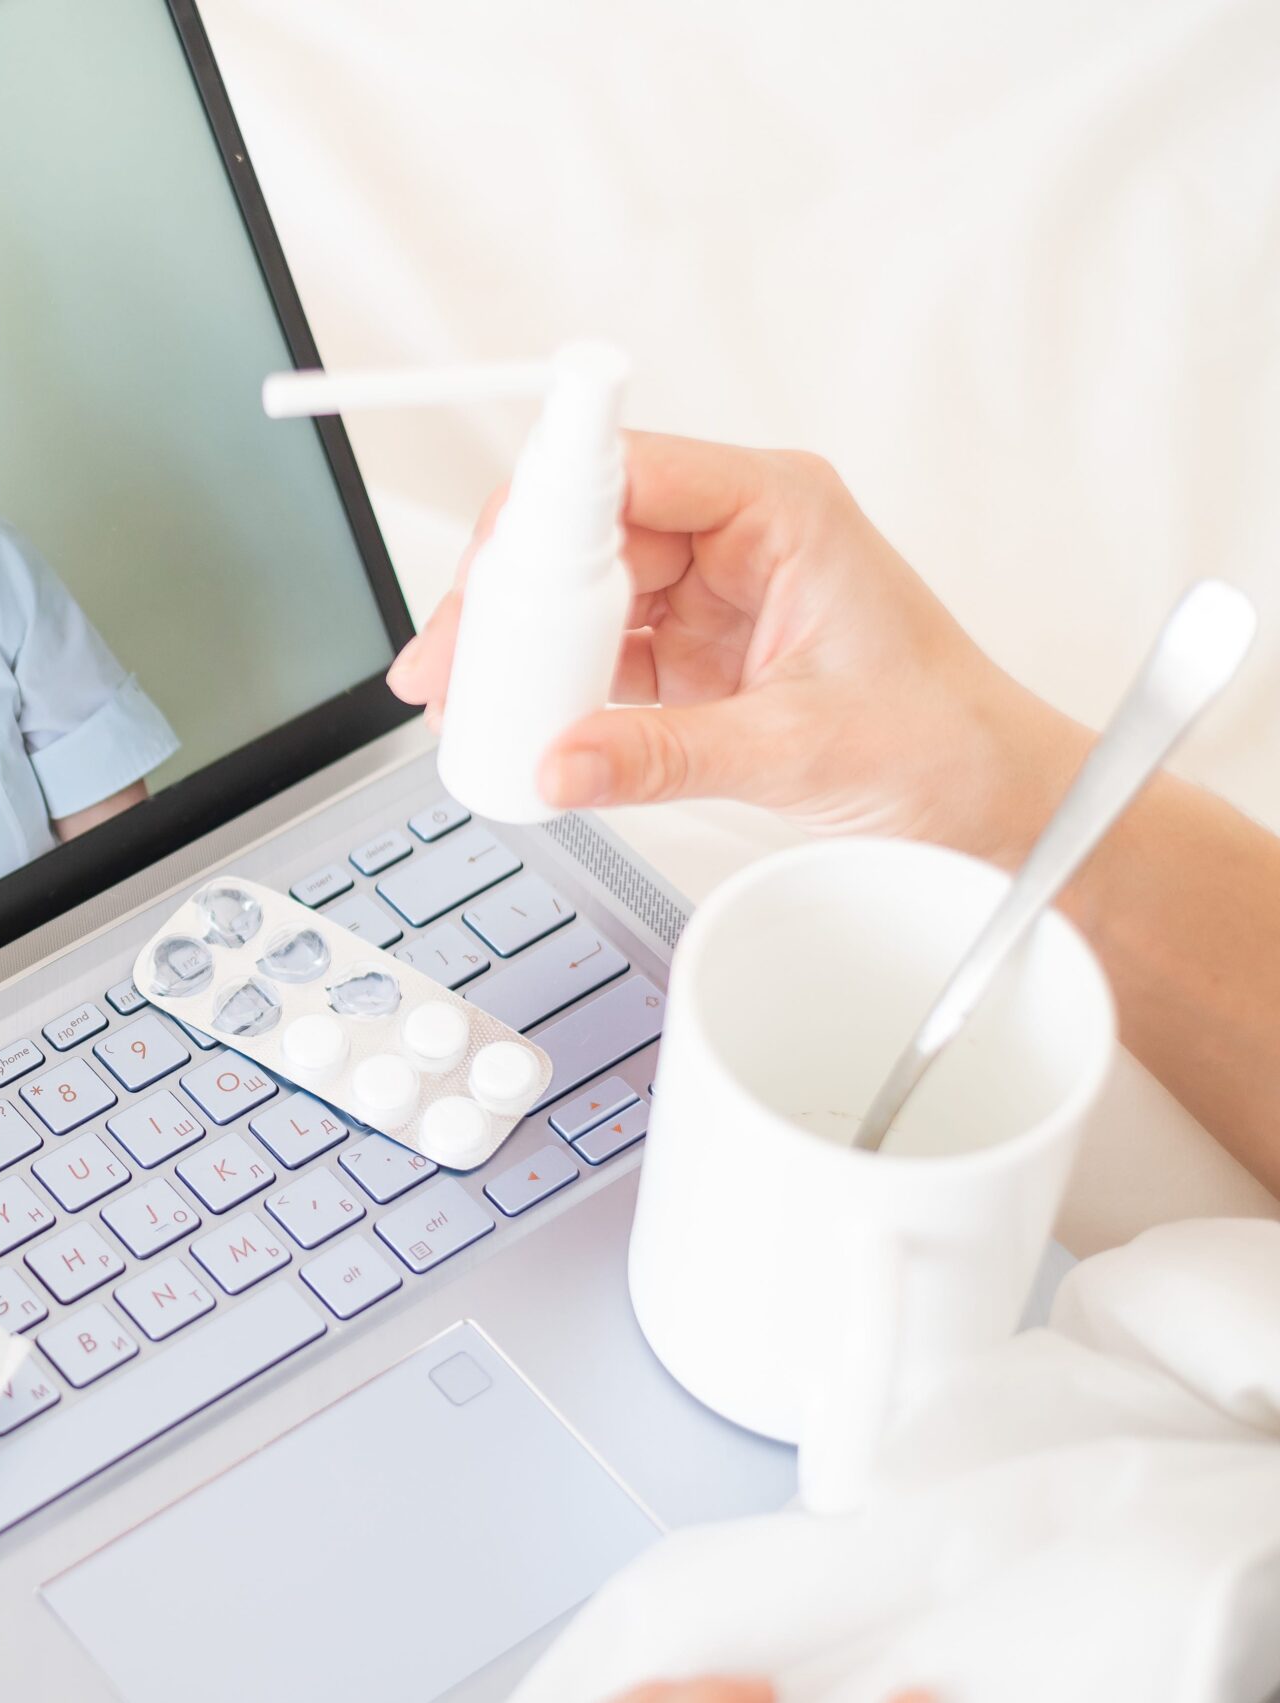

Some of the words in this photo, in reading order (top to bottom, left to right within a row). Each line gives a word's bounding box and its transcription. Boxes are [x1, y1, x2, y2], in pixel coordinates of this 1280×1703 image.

[70, 1011, 89, 1027] end
[57, 1028, 76, 1042] f10
[0, 1048, 30, 1068] home
[131, 1041, 146, 1059] 9
[217, 1073, 240, 1092] O
[244, 1074, 267, 1092] Щ
[58, 1084, 77, 1102] 8
[173, 1120, 194, 1136] Ш
[290, 1120, 309, 1136] L
[321, 1118, 339, 1135] Д
[68, 1158, 90, 1179] U
[213, 1159, 237, 1181] K
[250, 1164, 264, 1178] Л
[408, 1154, 428, 1170] Ю
[146, 1205, 158, 1224] J
[339, 1200, 353, 1212] Б
[426, 1211, 448, 1232] ctrl
[229, 1237, 257, 1263] M
[62, 1248, 85, 1272] H
[343, 1266, 361, 1283] alt
[152, 1283, 176, 1308] N
[21, 1300, 37, 1315] П
[78, 1333, 97, 1354] B
